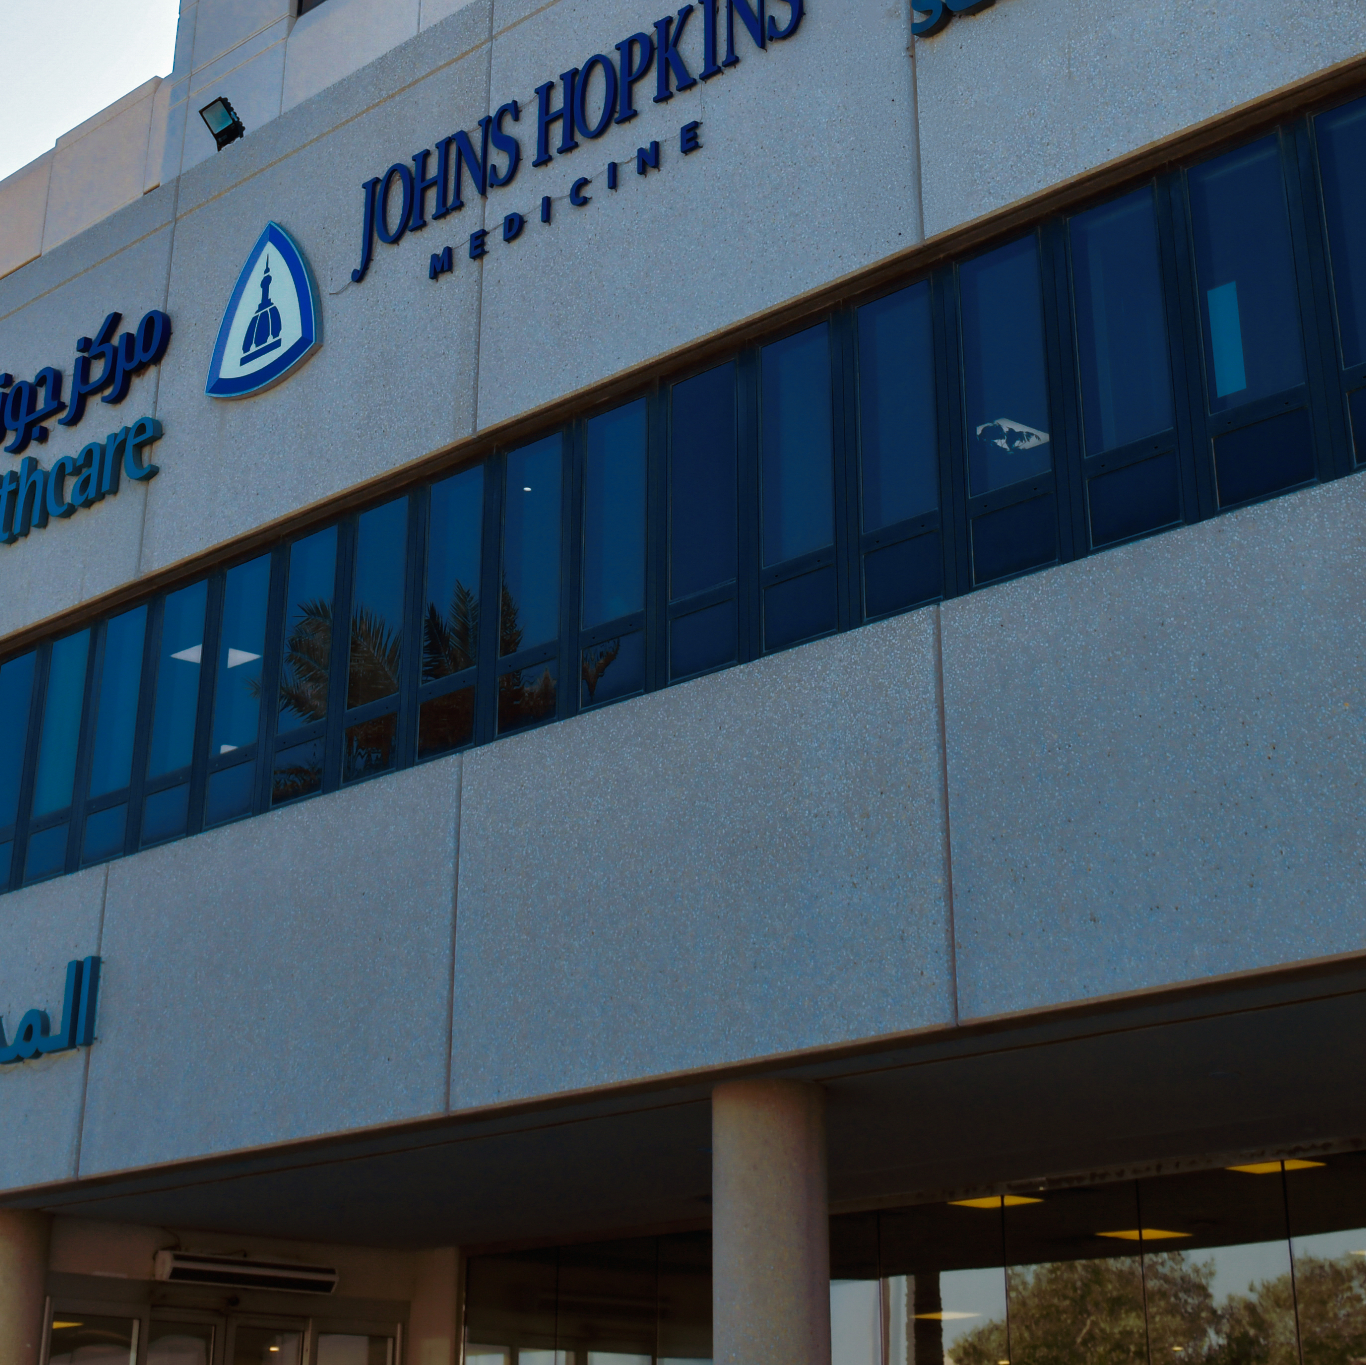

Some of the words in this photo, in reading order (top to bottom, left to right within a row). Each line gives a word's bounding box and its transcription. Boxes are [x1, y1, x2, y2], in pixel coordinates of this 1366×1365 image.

[351, 100, 522, 283] JOHNS
[429, 119, 703, 280] MEDICINE
[58, 309, 172, 427] مركز
